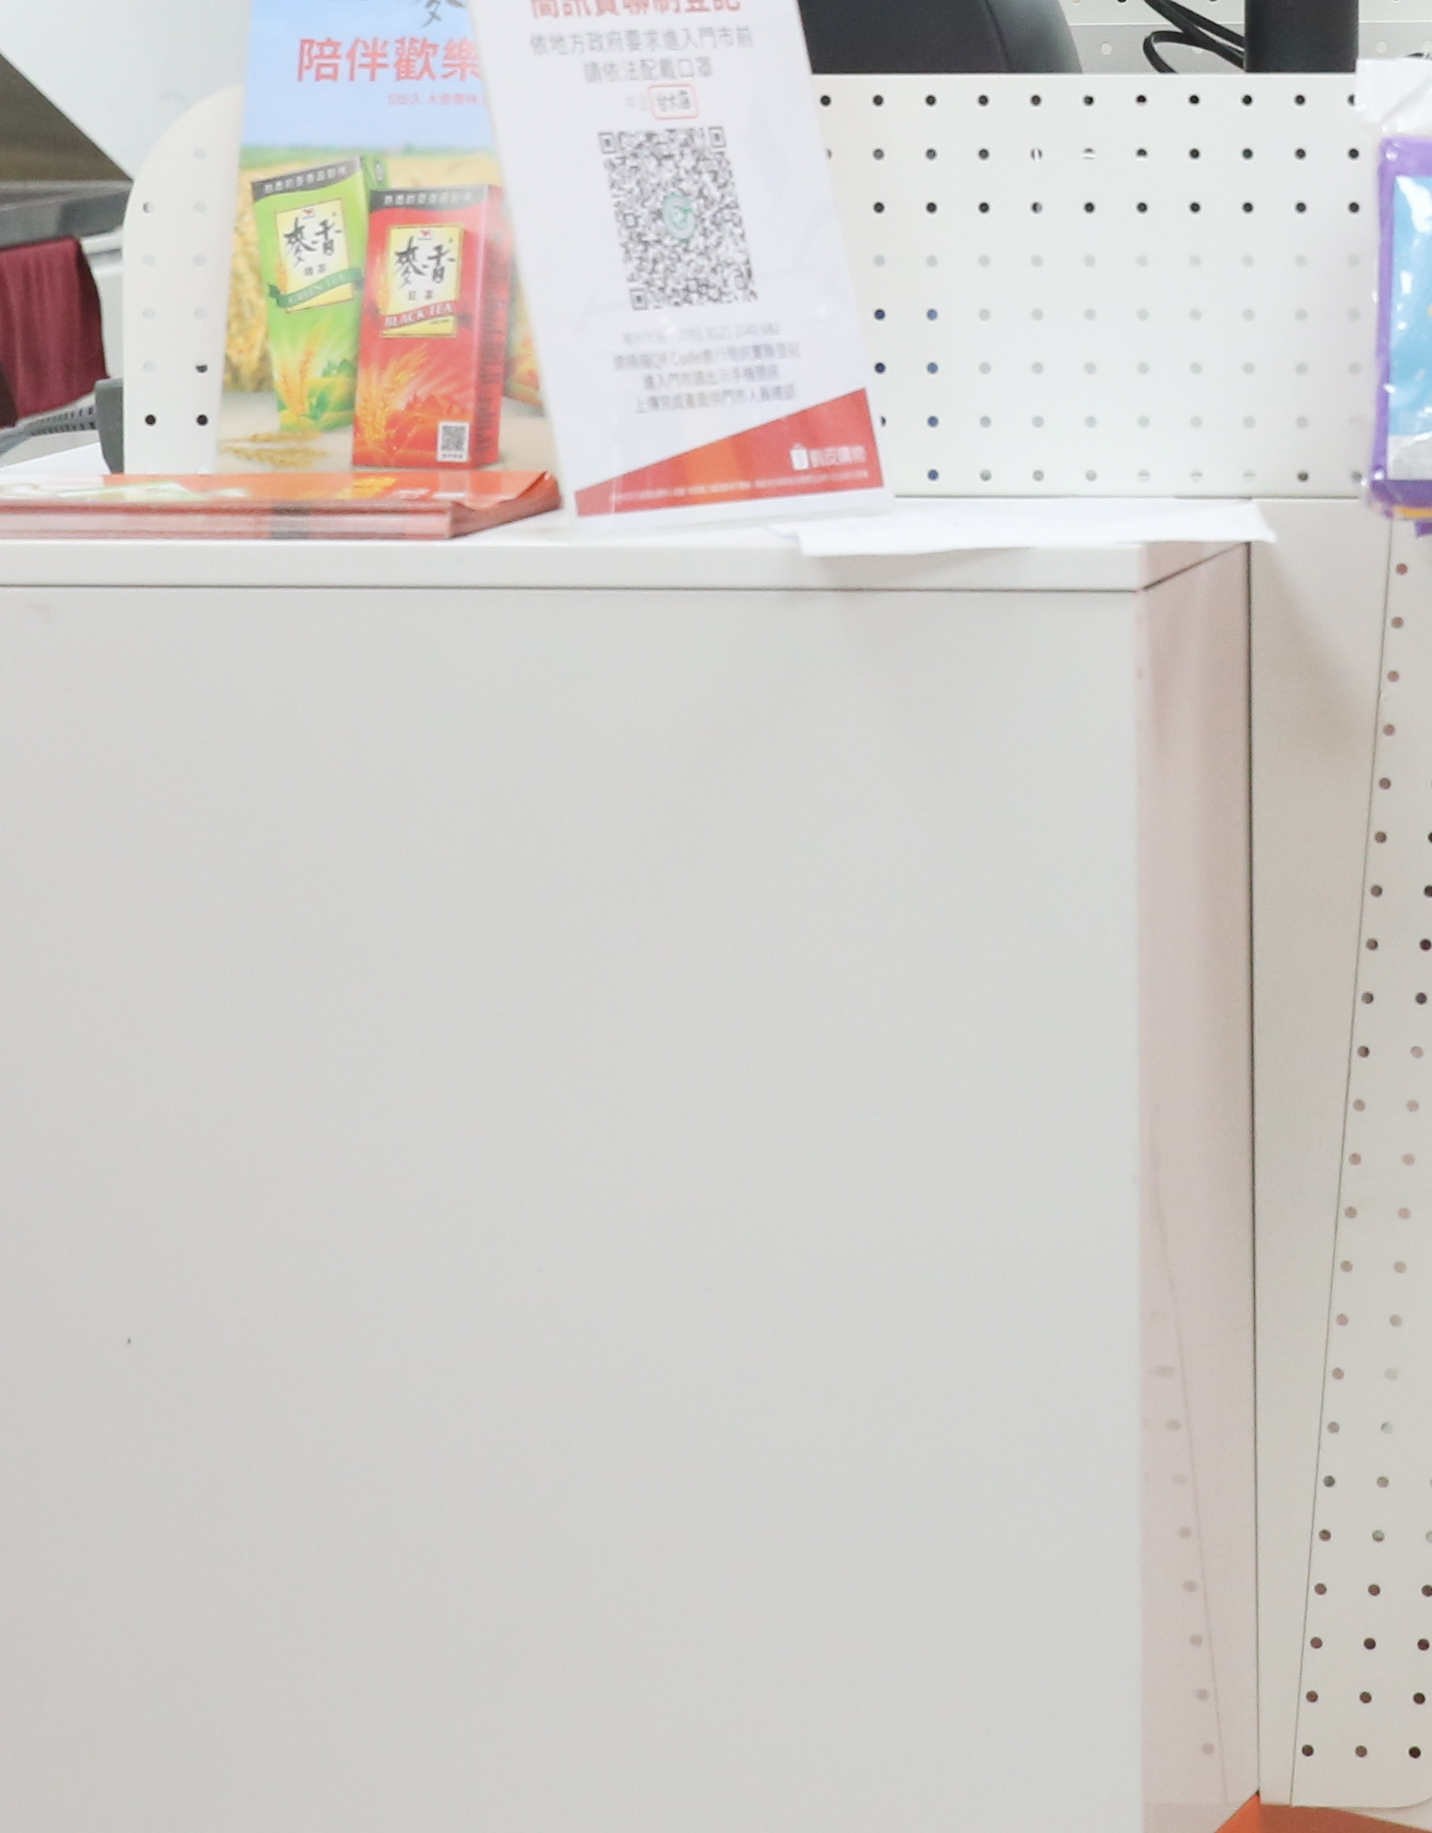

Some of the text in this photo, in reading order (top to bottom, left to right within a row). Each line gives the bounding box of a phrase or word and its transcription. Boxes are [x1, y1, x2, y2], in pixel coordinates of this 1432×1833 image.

[284, 218, 343, 269] 麥香
[395, 235, 456, 291] 麥香
[384, 302, 453, 329] BLACK TEA
